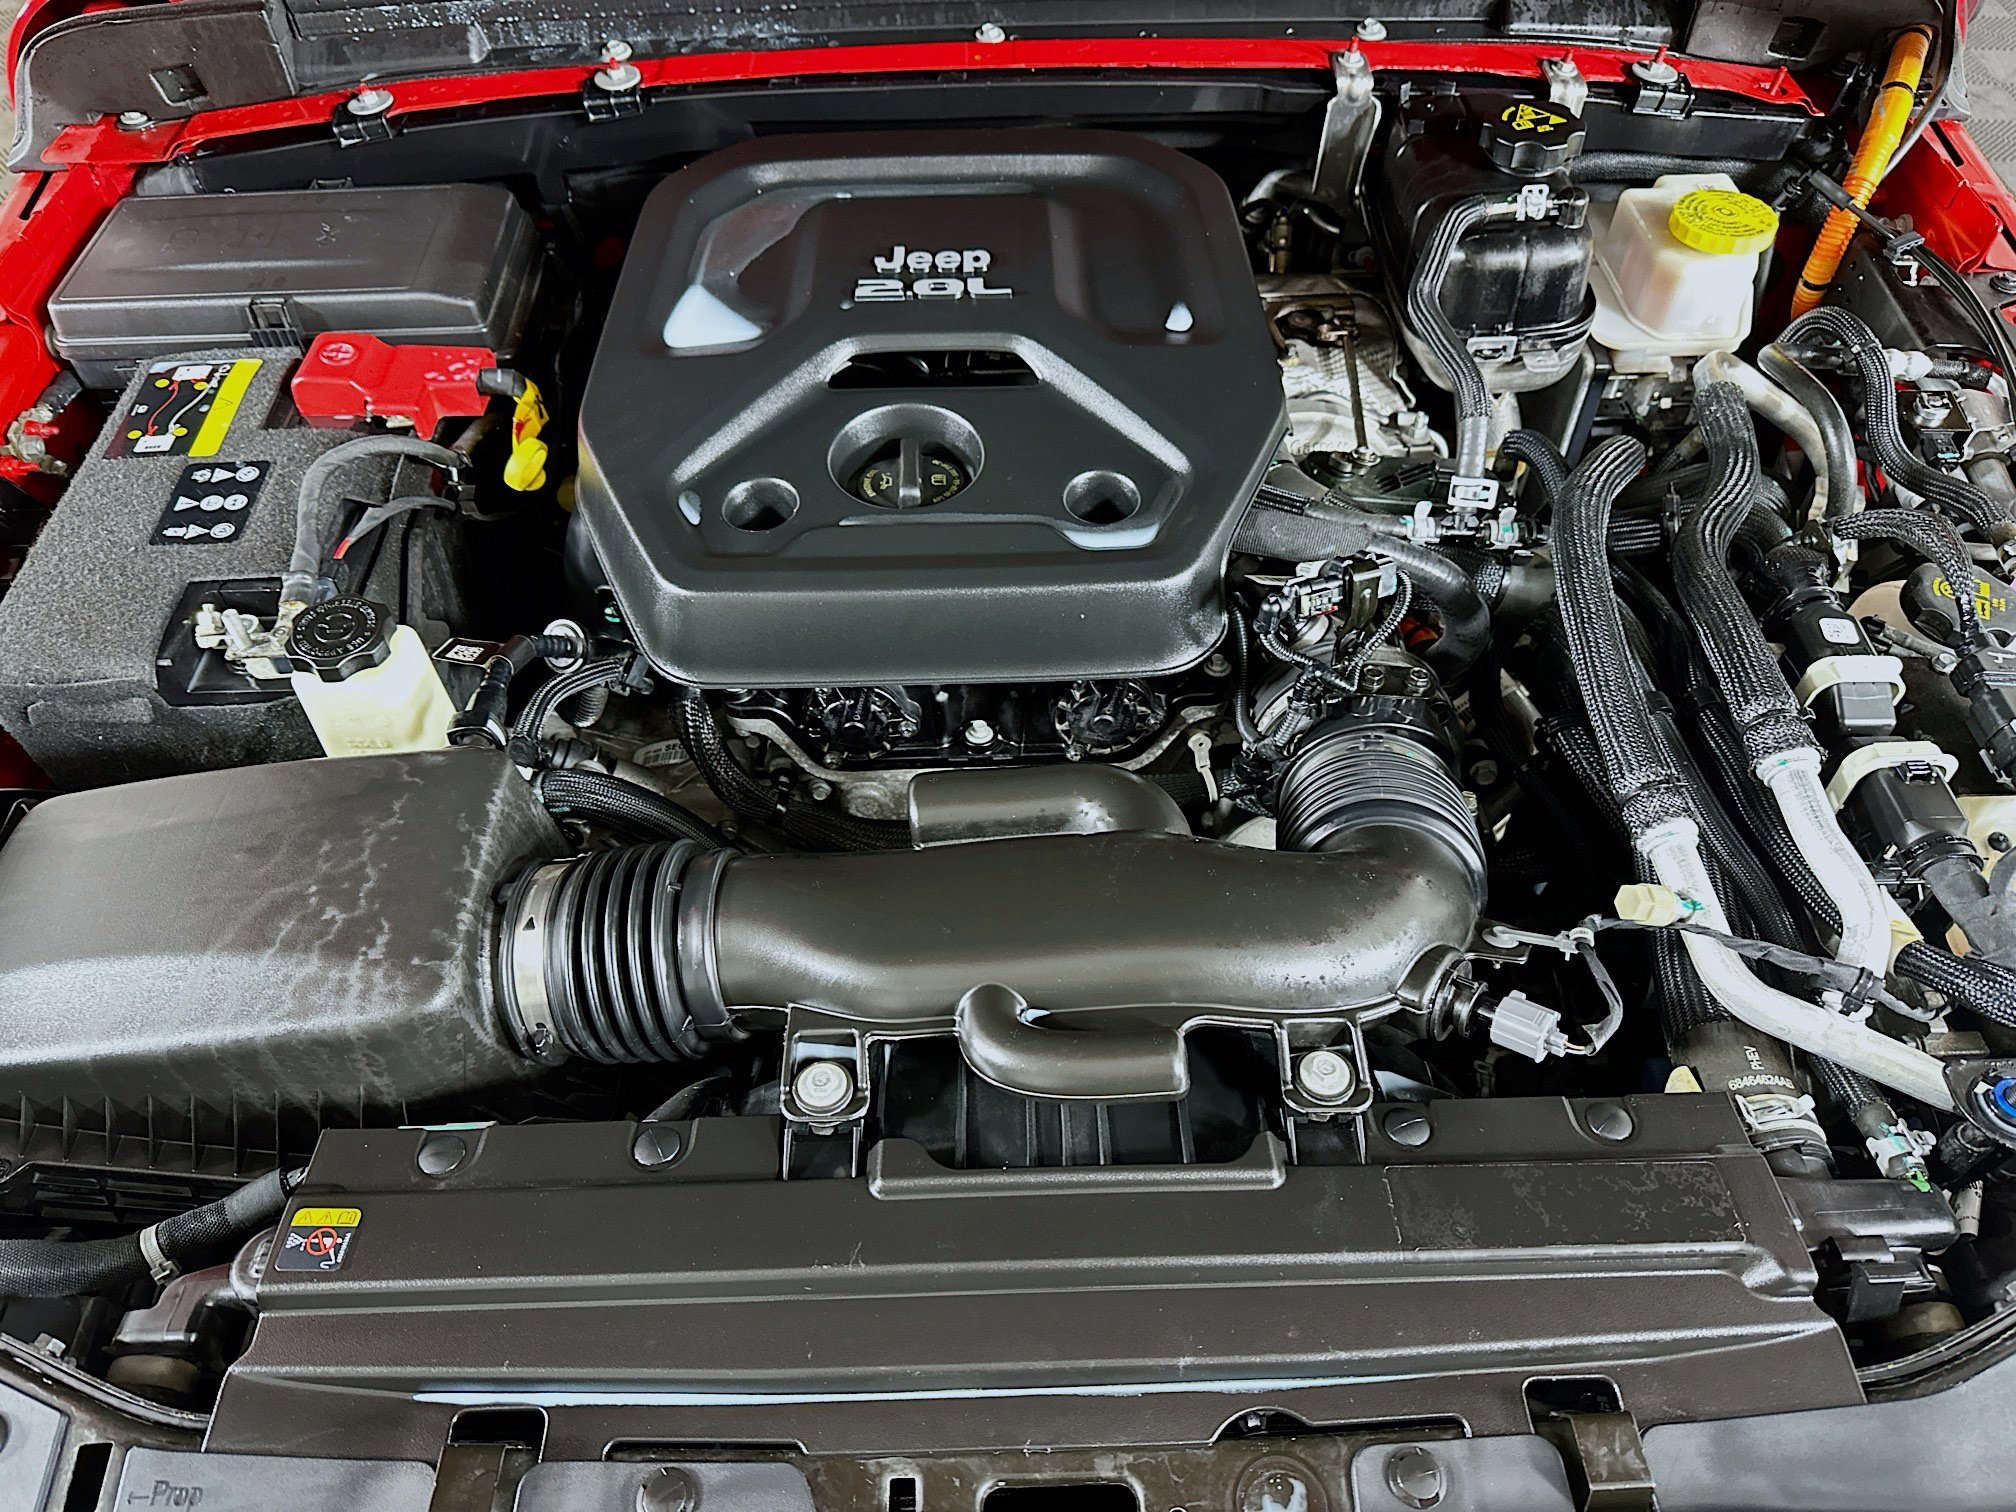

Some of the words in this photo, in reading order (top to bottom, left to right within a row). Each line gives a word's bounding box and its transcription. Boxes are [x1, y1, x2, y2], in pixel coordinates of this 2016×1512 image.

[874, 246, 991, 273] Jeep
[854, 277, 1013, 301] 2.0L
[1743, 1045, 1765, 1070] PHEV
